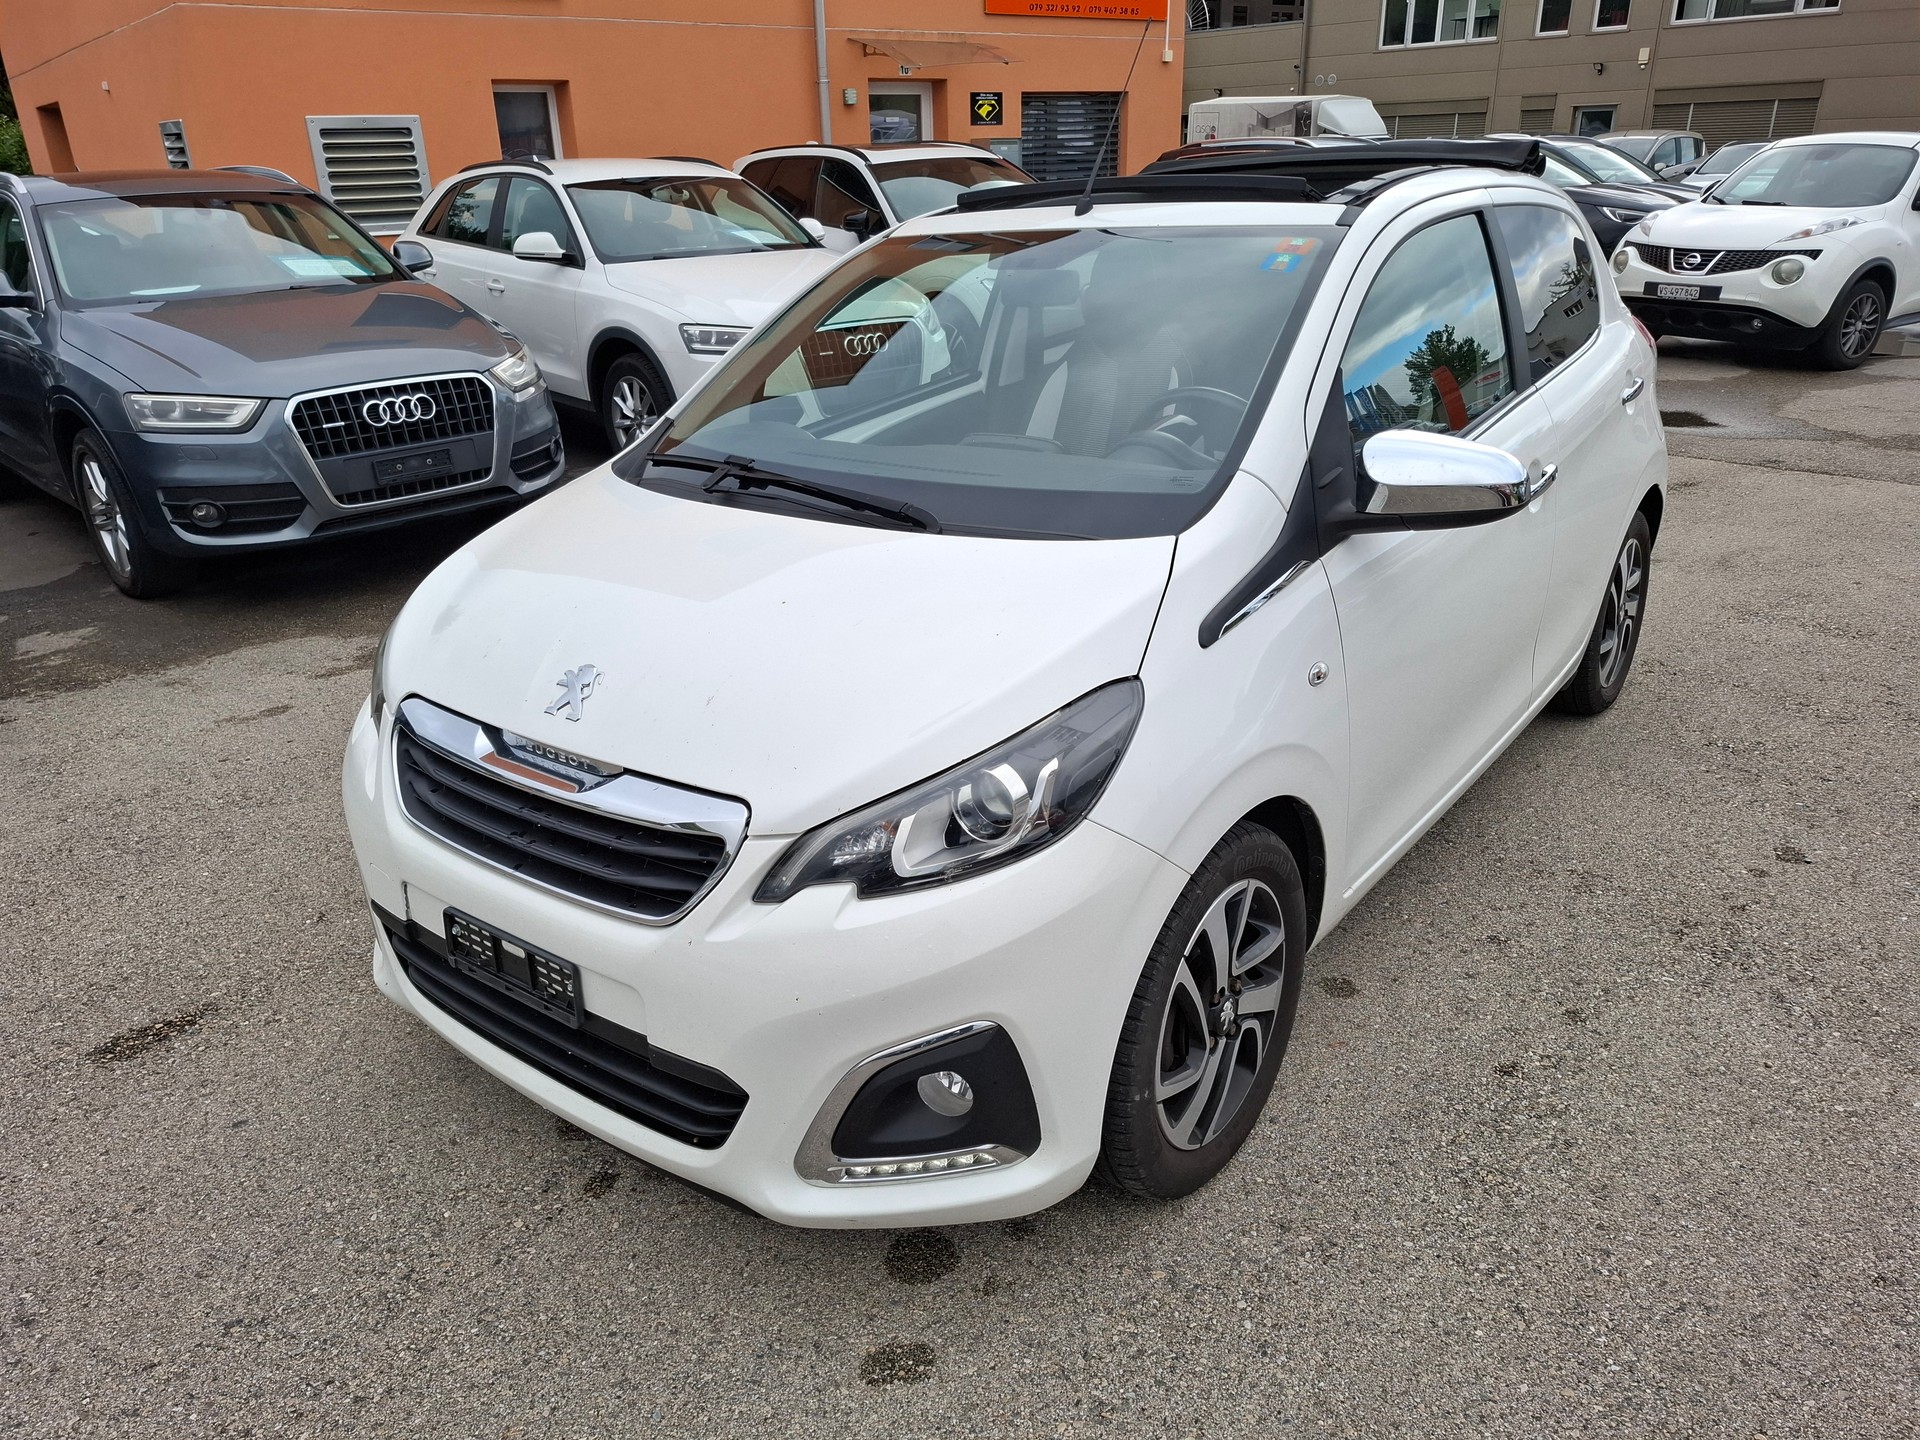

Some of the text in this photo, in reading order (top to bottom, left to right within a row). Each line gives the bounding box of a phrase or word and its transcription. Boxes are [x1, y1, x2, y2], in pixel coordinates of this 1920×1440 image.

[1045, 4, 1058, 12] 321
[1071, 5, 1081, 13] 92
[1088, 6, 1102, 14] 079
[1119, 7, 1129, 15] 38
[515, 736, 590, 769] PEUGEOT
[1234, 847, 1291, 879] Continental
